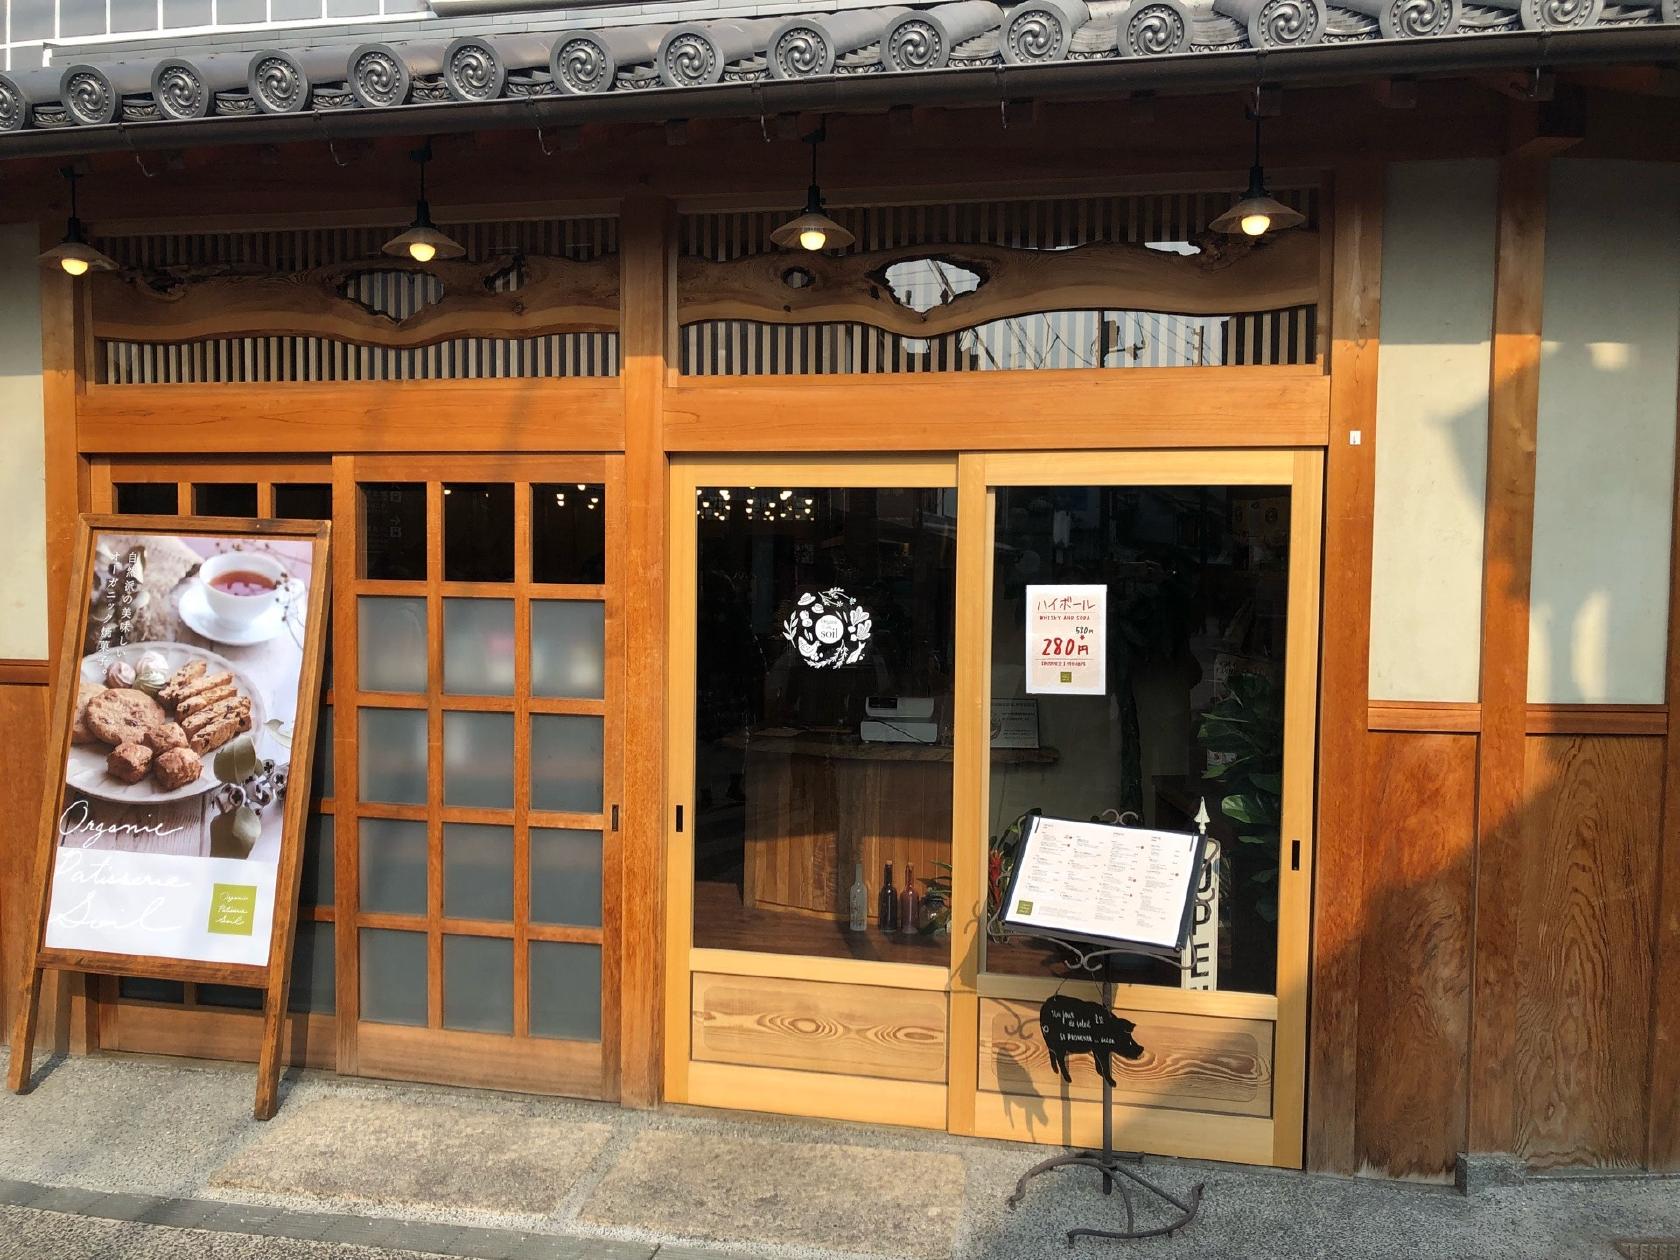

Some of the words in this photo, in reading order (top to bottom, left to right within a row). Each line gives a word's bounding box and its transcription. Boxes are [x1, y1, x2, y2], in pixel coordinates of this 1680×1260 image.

[116, 551, 138, 658] 自然派の美味しい
[1037, 596, 1096, 611] ハイボール
[820, 628, 838, 639] soil
[1041, 637, 1089, 656] 280円
[59, 800, 184, 848] Organic
[50, 889, 182, 932] Soil
